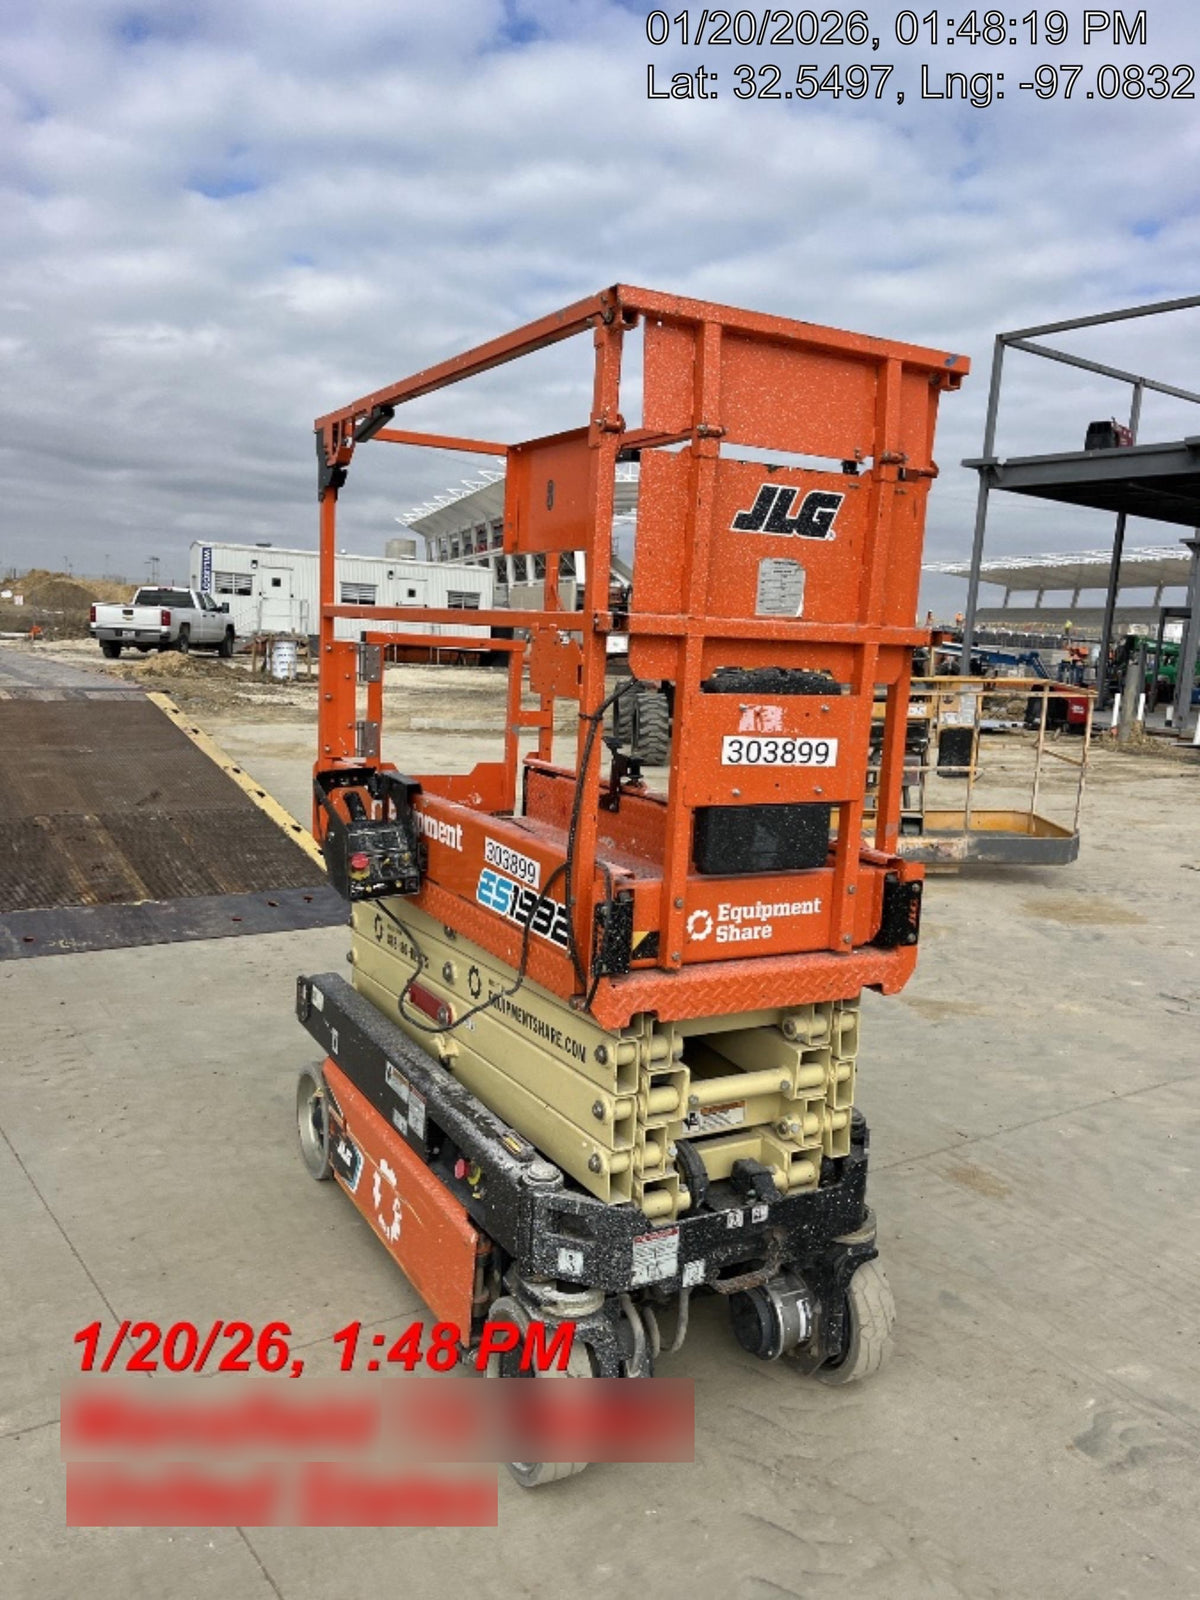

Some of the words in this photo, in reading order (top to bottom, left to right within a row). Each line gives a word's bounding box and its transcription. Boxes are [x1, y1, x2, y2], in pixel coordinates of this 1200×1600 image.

[729, 483, 846, 540] JLG
[727, 739, 830, 765] 303899
[486, 842, 536, 884] 303899
[717, 897, 822, 924] Equipment
[716, 924, 773, 943] Share
[488, 989, 586, 1064] EUIPMENTSHARE.COM
